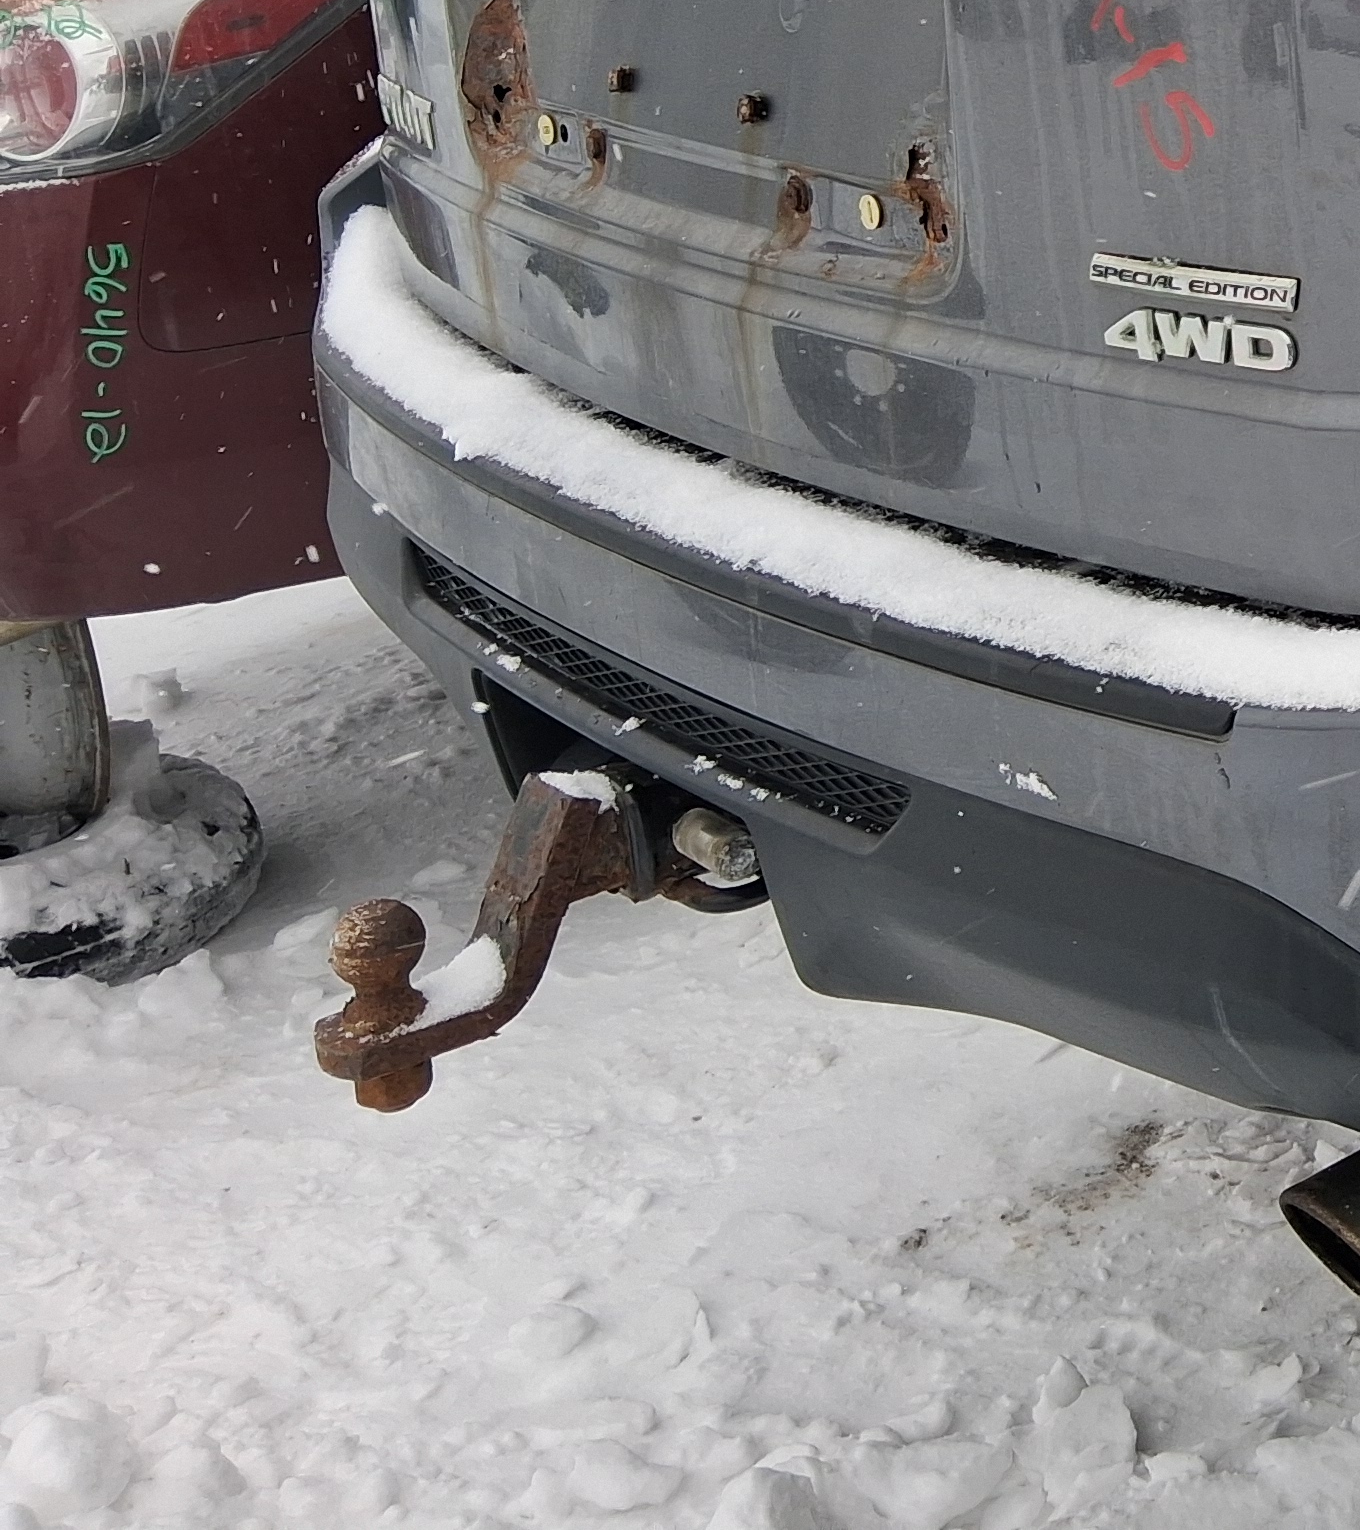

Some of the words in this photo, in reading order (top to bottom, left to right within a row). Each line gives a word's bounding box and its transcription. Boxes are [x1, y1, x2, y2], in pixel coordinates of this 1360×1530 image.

[1091, 263, 1182, 292] SPECIAL
[1188, 278, 1289, 304] EDITION
[1103, 306, 1298, 372] 4WD
